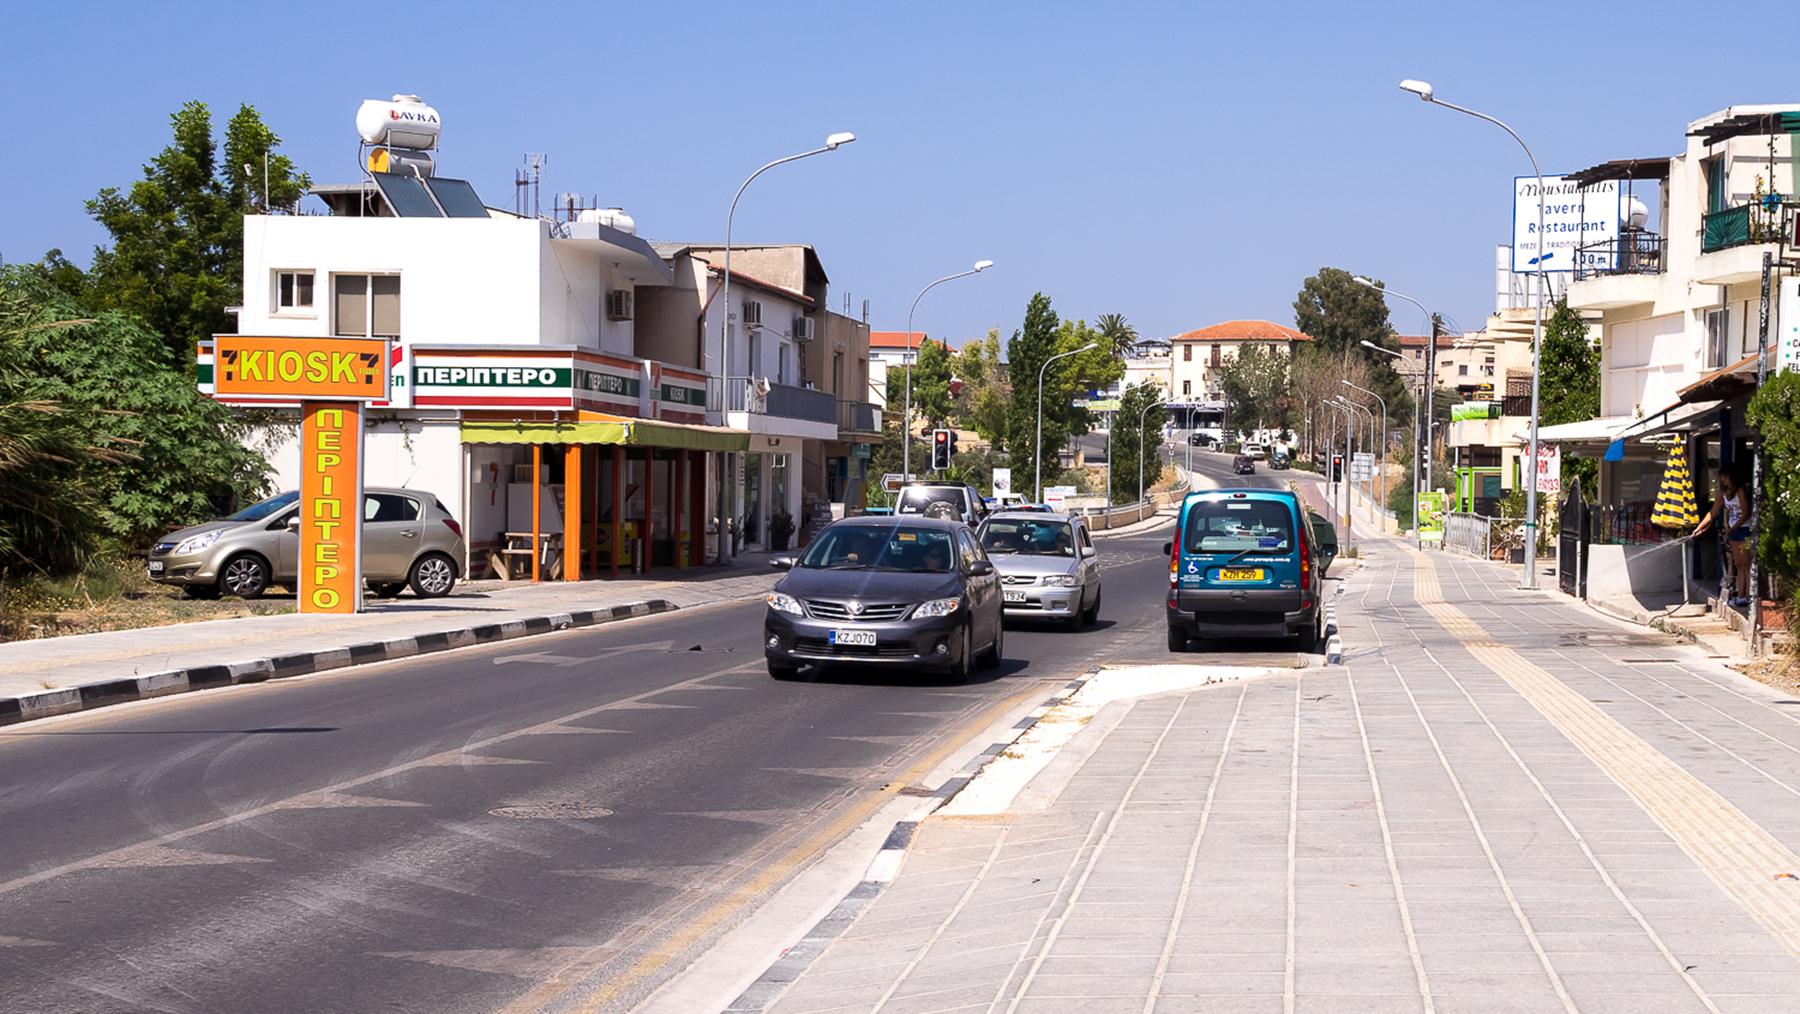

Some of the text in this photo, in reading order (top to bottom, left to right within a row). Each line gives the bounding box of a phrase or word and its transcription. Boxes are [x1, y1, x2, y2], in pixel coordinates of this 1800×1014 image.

[1528, 221, 1605, 233] Restaurant
[240, 350, 358, 383] KIOSK
[417, 368, 557, 385] ΠΕΡΙΠΤΕΡΟ
[670, 387, 686, 402] KIOSK
